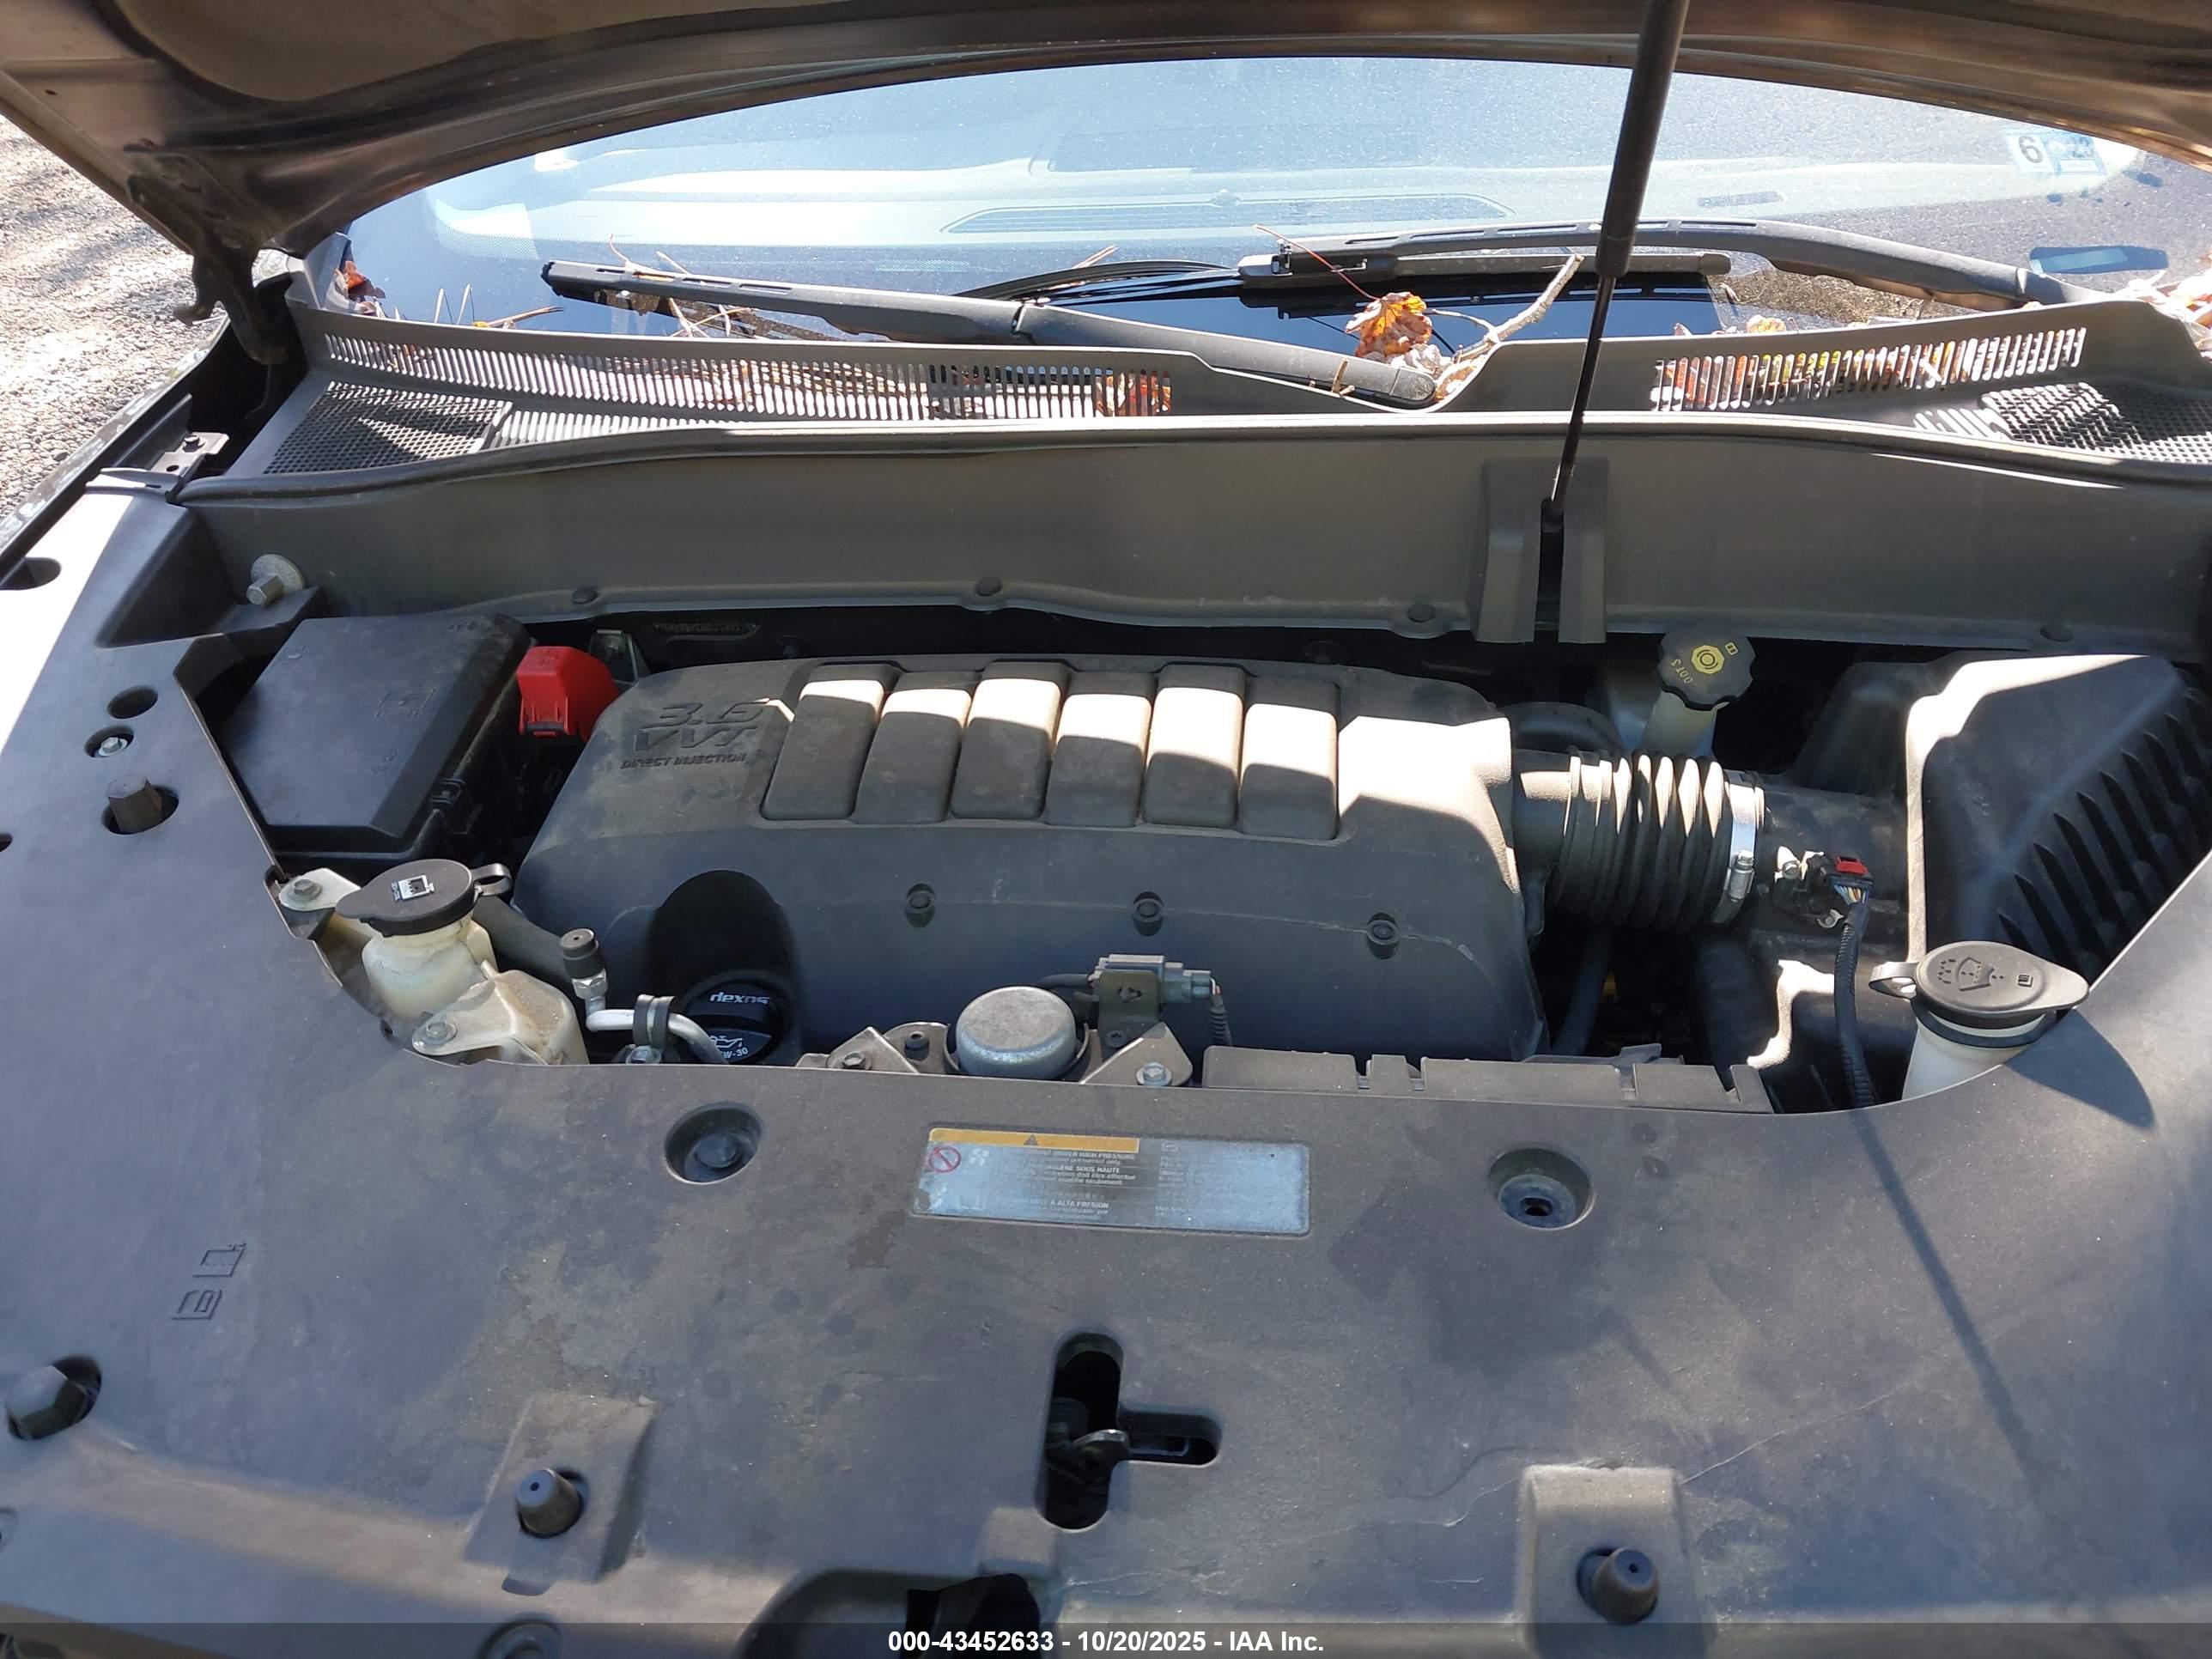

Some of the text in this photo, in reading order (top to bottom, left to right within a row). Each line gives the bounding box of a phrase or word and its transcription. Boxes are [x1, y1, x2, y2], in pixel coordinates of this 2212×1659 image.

[2018, 136, 2043, 163] 6
[1675, 666, 1693, 684] DOT
[620, 752, 747, 769] DIRECT INJECTION
